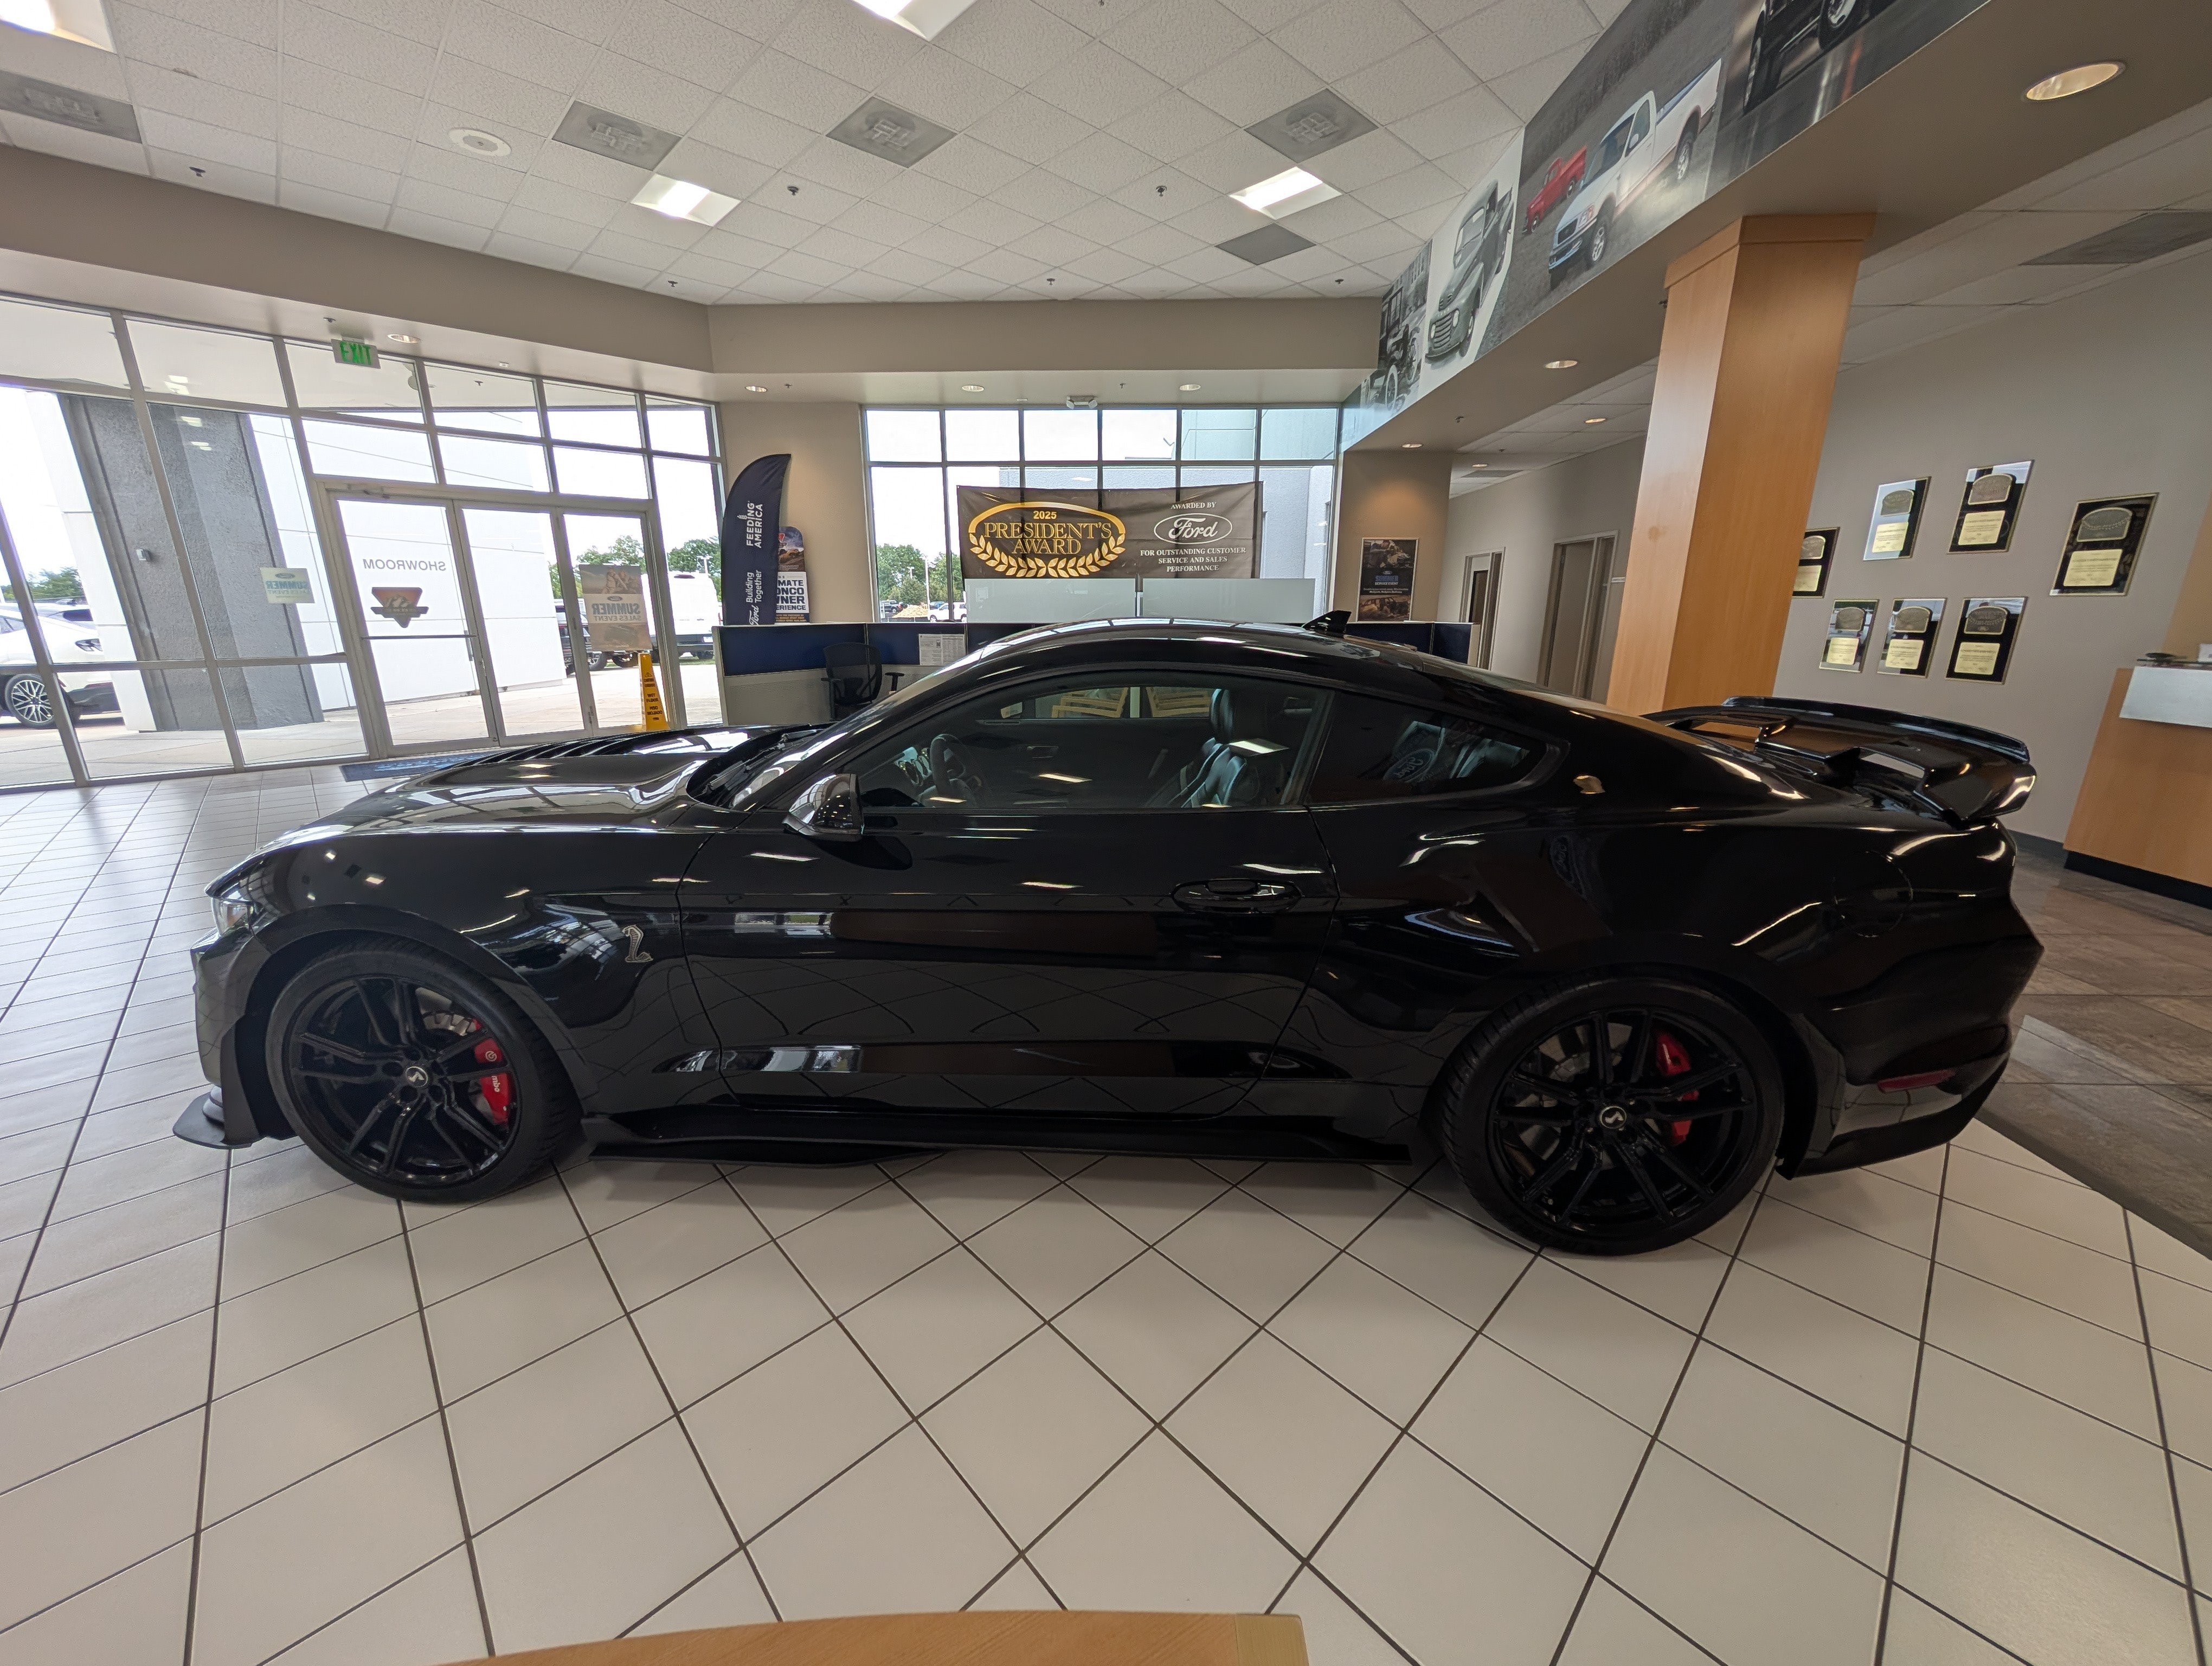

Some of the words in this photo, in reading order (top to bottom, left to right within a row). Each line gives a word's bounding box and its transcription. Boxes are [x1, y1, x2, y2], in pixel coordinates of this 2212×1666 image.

[339, 341, 372, 366] EXIT
[746, 503, 755, 546] FEEDING
[754, 504, 763, 548] AMERICA
[1033, 510, 1057, 520] 2025
[983, 522, 1112, 539] PRESIDENT'S
[1168, 517, 1218, 539] Ford
[1011, 539, 1082, 554] AWARD
[745, 572, 754, 603] Building
[754, 569, 763, 603] Together
[749, 605, 759, 625] Ford
